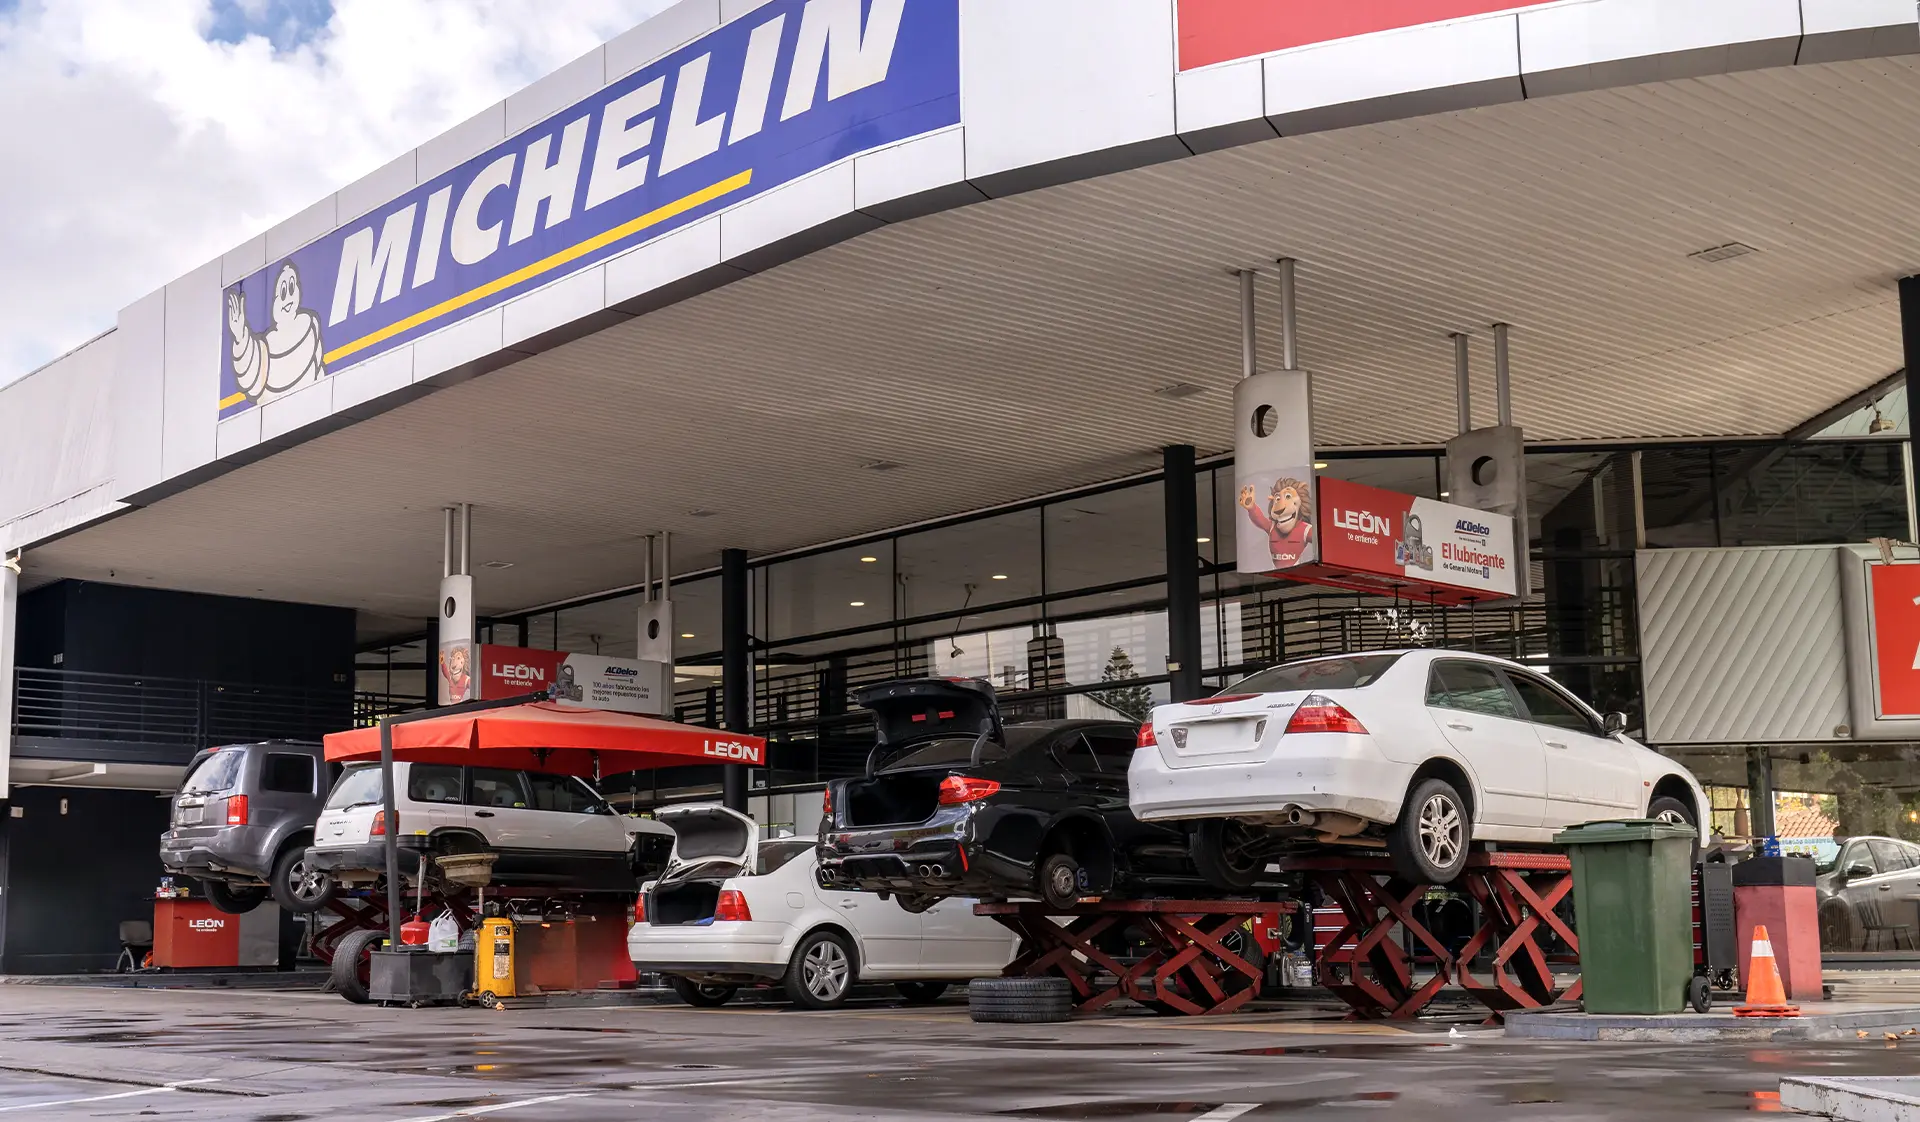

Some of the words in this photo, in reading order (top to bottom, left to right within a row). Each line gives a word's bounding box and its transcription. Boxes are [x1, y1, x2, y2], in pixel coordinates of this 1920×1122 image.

[328, 0, 904, 328] MICHELIN
[1455, 519, 1490, 535] ACDelco
[1347, 533, 1354, 541] te
[1441, 542, 1452, 560] El
[1453, 543, 1505, 570] lubricante
[1449, 564, 1467, 573] General
[1467, 566, 1483, 576] Motors
[605, 666, 638, 676] ACDelco
[592, 681, 601, 689] 100
[615, 683, 641, 692] fabricando
[592, 689, 612, 697] mejores
[612, 690, 637, 698] repuestos
